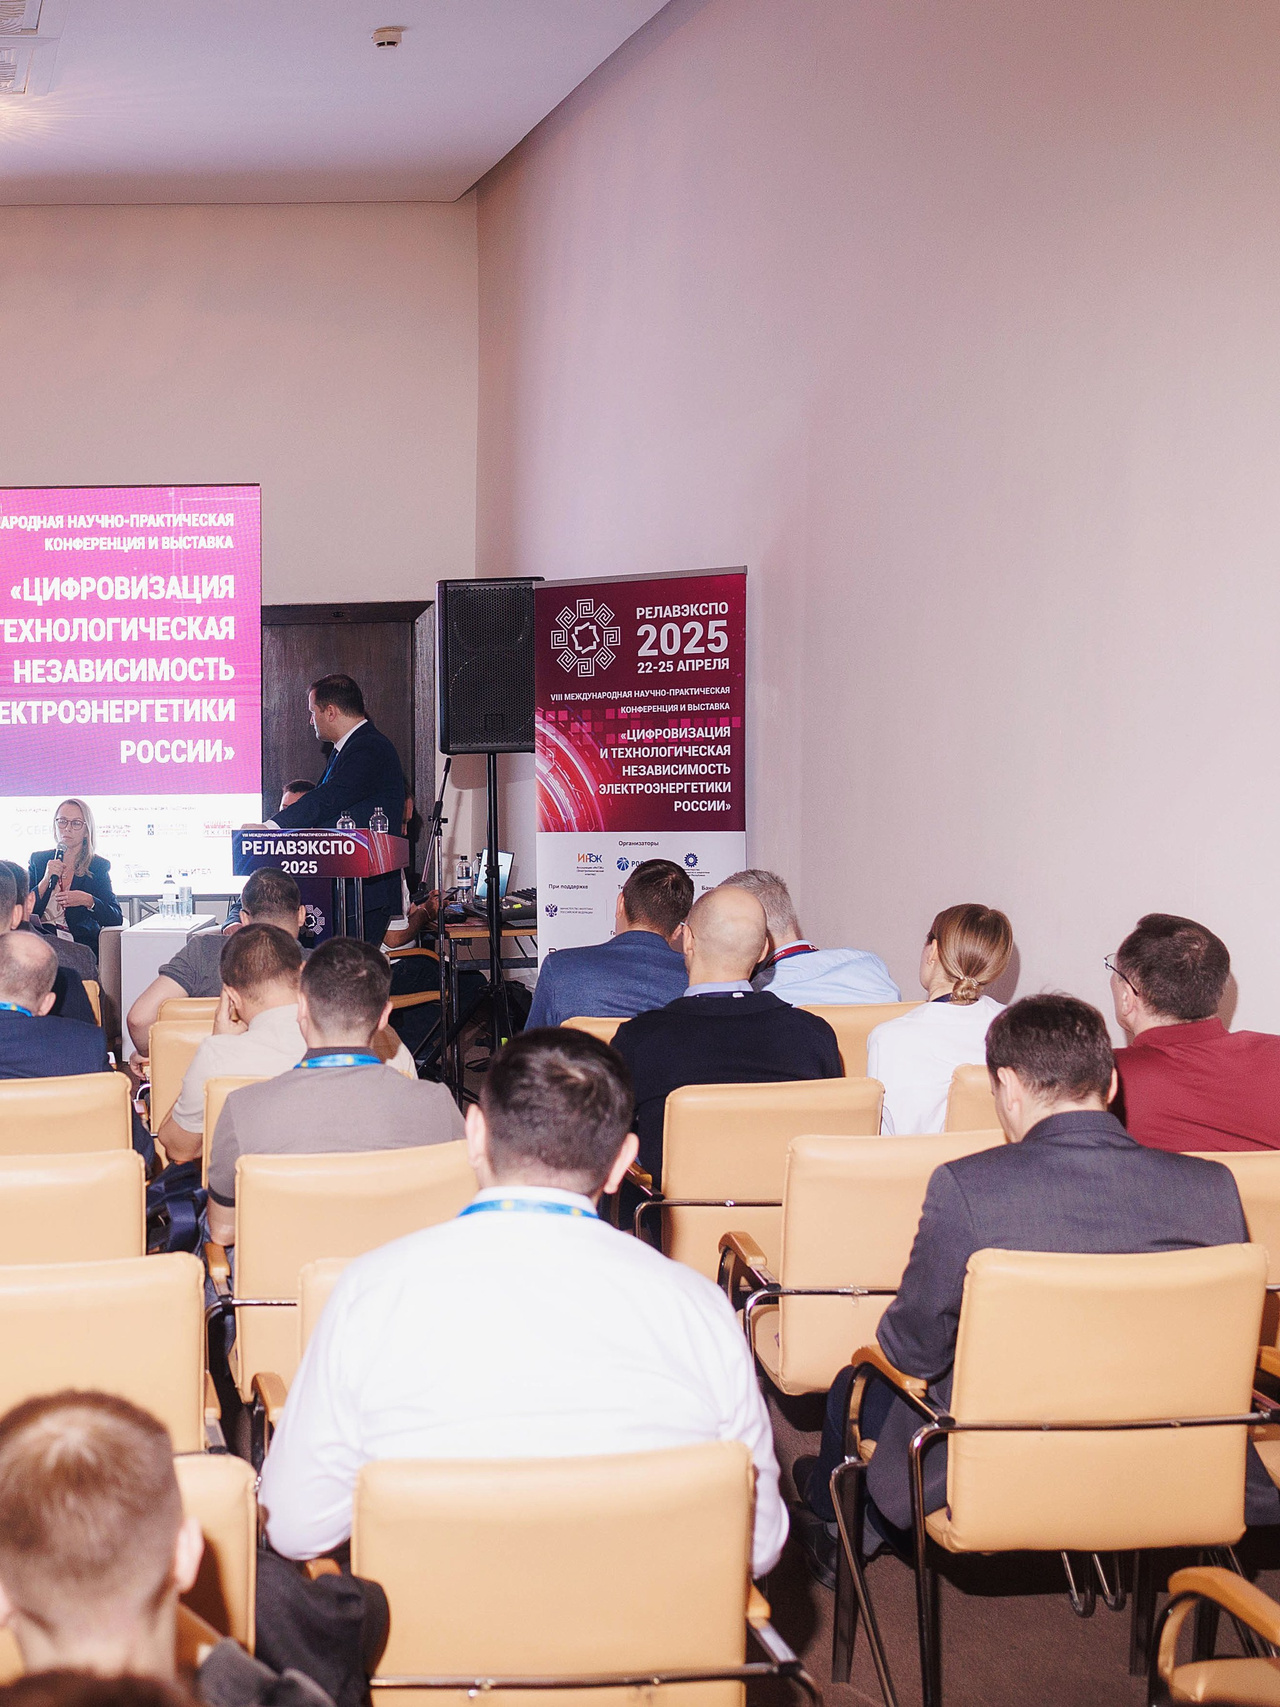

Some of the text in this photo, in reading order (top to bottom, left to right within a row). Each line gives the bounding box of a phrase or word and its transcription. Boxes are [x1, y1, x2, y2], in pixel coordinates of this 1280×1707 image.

[67, 512, 234, 528] НАУЧНО-ПРАКТИЧЕСКАЯ
[44, 535, 234, 554] КОНФЕРЕНЦИЯ И ВЫСТАВКА
[10, 575, 235, 607] «ЦИФРОВИЗАЦИЯ
[635, 601, 729, 620] РЕЛАВЭКСПО
[636, 619, 729, 657] 2025
[13, 657, 235, 684] НЕЗАВИСИМОСТЬ
[636, 657, 730, 674] 22-25 АПРЕЛЯ
[550, 686, 731, 702] VIII МЕЖДУНАРОДНАЯ НАУЧНО-ПРАКТИЧЕСКАЯ
[620, 702, 730, 714] КОНФЕРЕНЦИЯ И ВЫСТАВКА
[620, 726, 731, 742] «ЦИФРОВИЗАЦИЯ
[120, 739, 235, 765] РОССИИ»
[599, 744, 731, 760] И ТЕХНОЛОГИЧЕСКАЯ
[622, 763, 731, 777] НЕЗАВИСИМОСТЬ
[598, 781, 732, 796] ЭЛЕКТРОЭНЕРГЕТИКИ
[673, 799, 732, 812] РОССИИ»
[26, 824, 53, 836] СБЕ
[241, 840, 356, 855] РЕЛАВЭКСПО
[280, 860, 318, 874] 2025
